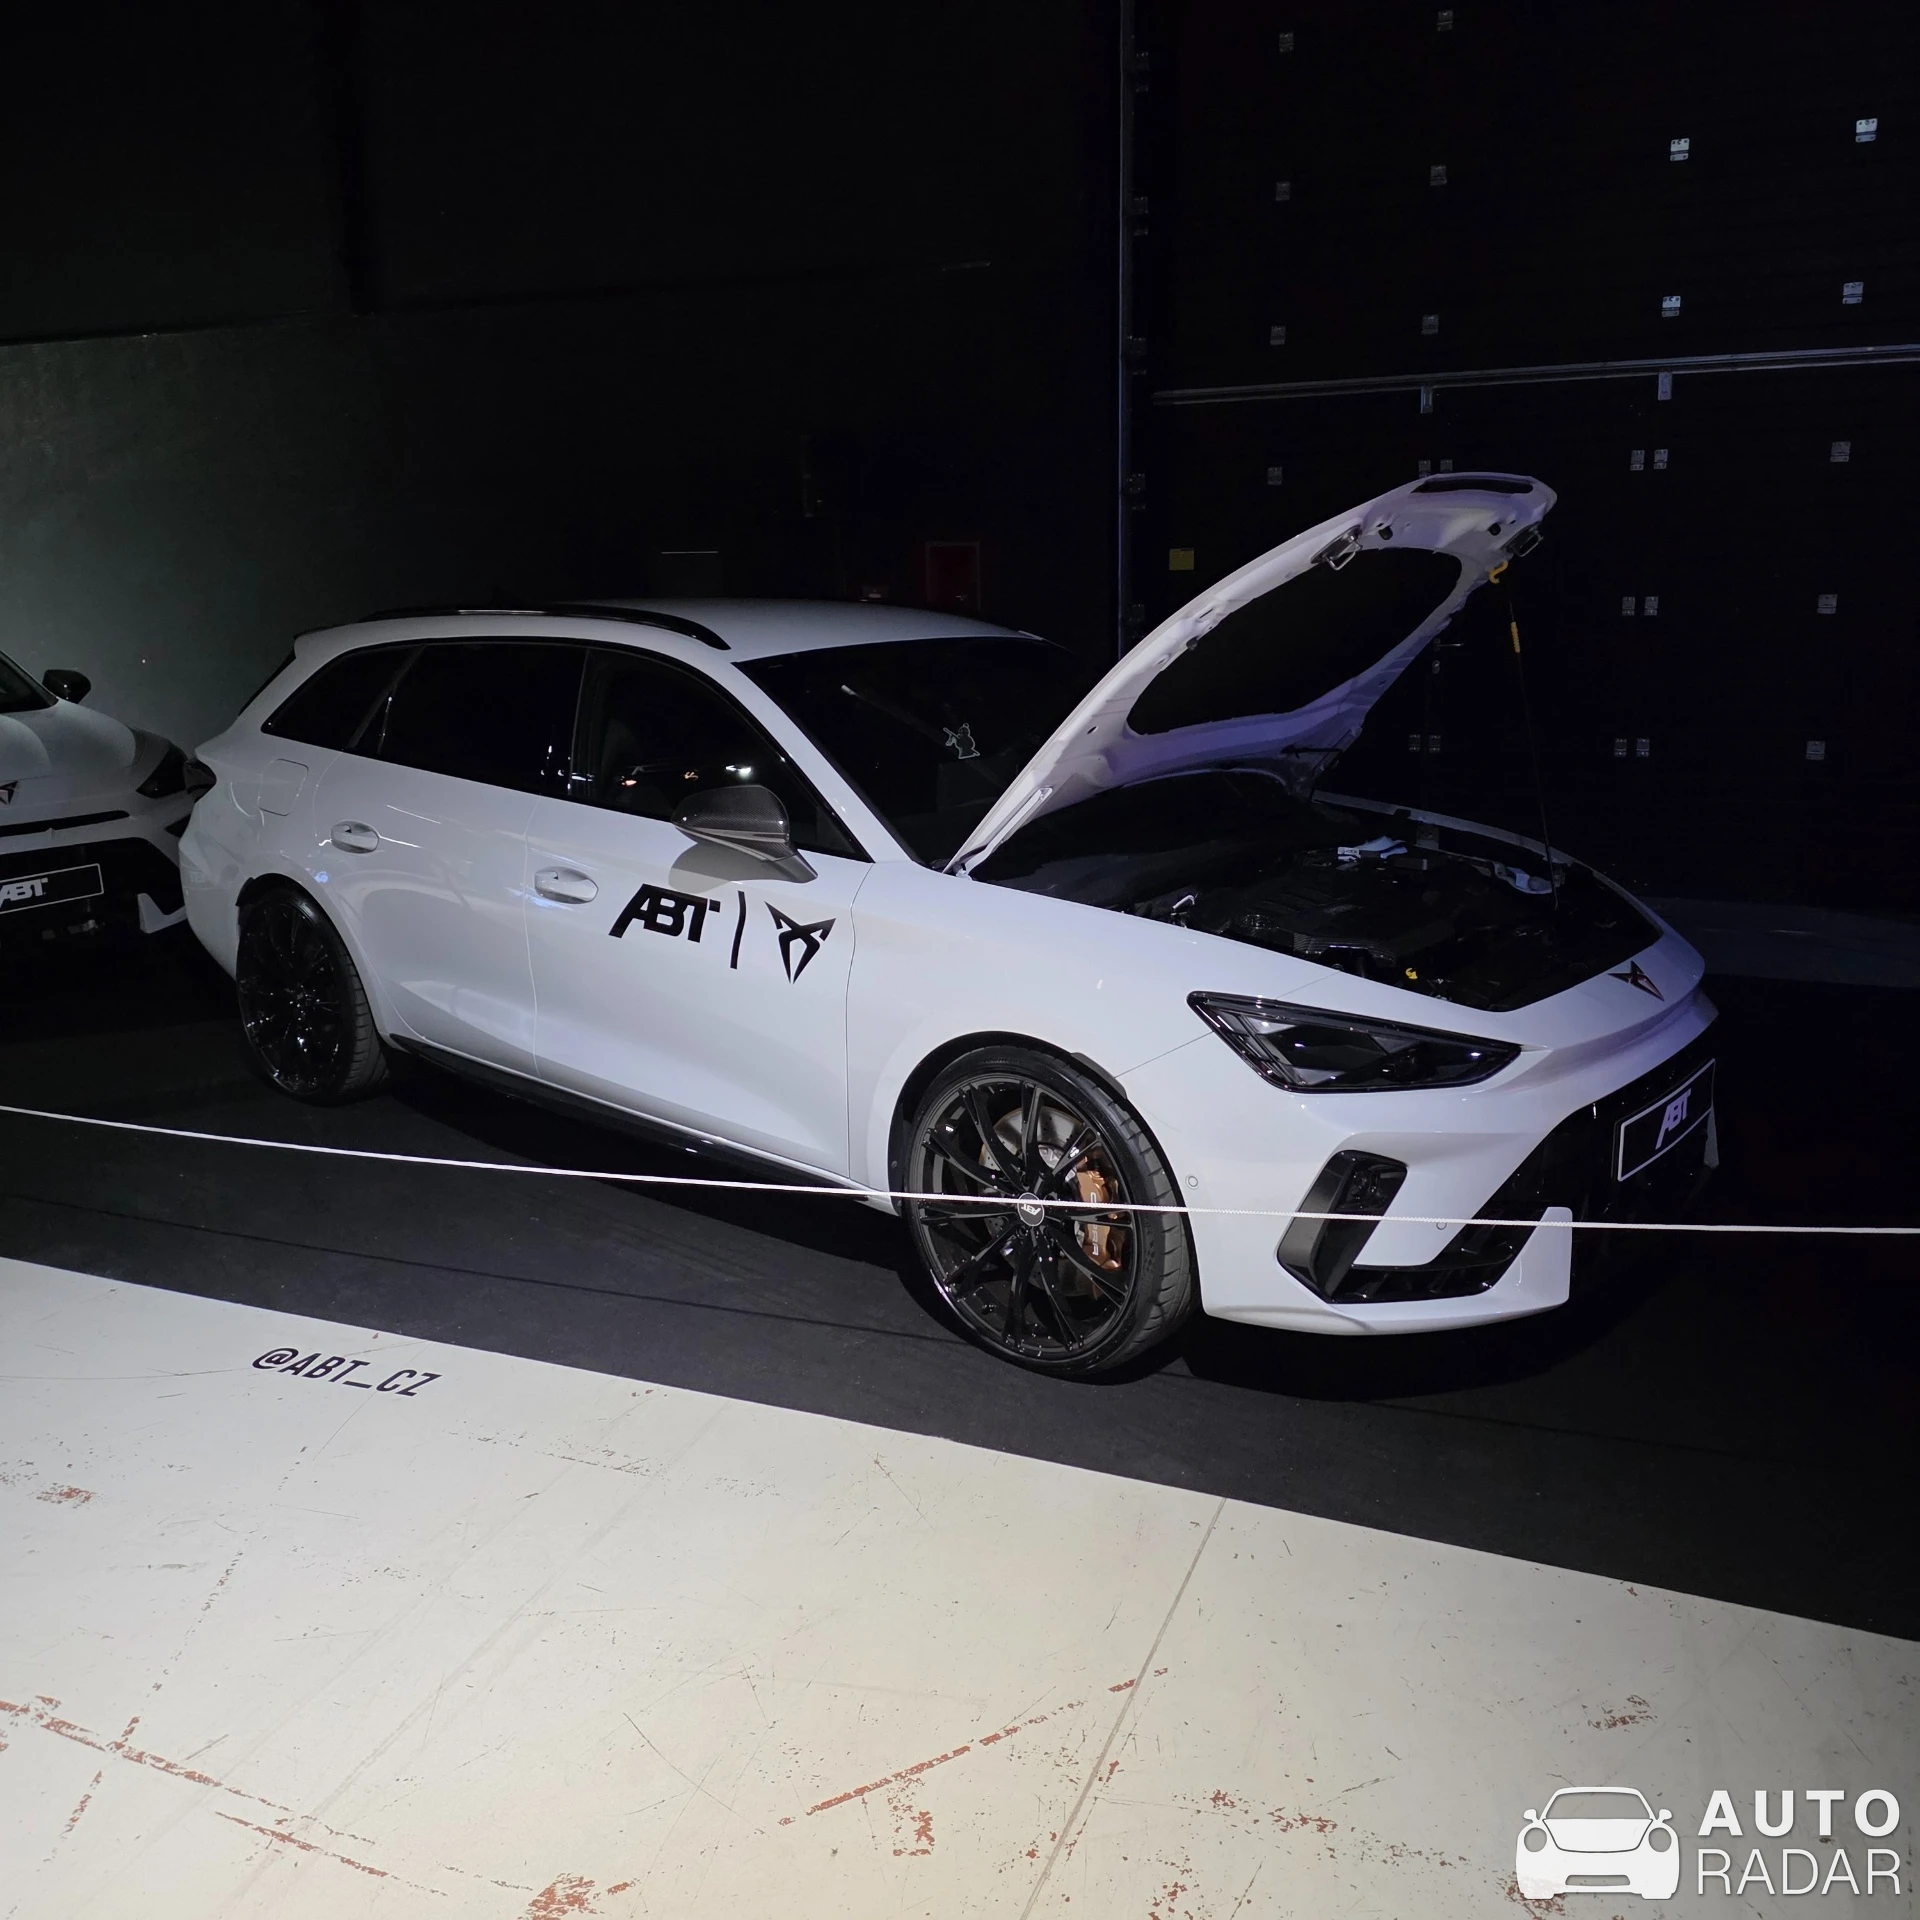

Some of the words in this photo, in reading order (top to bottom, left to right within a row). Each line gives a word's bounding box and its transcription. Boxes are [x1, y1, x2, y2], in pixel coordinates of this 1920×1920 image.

[0, 877, 49, 909] ABT
[608, 883, 721, 943] ABT
[1655, 1087, 1692, 1150] ABT
[1021, 1203, 1042, 1216] ABT
[252, 1347, 443, 1397] @ABT_CZ
